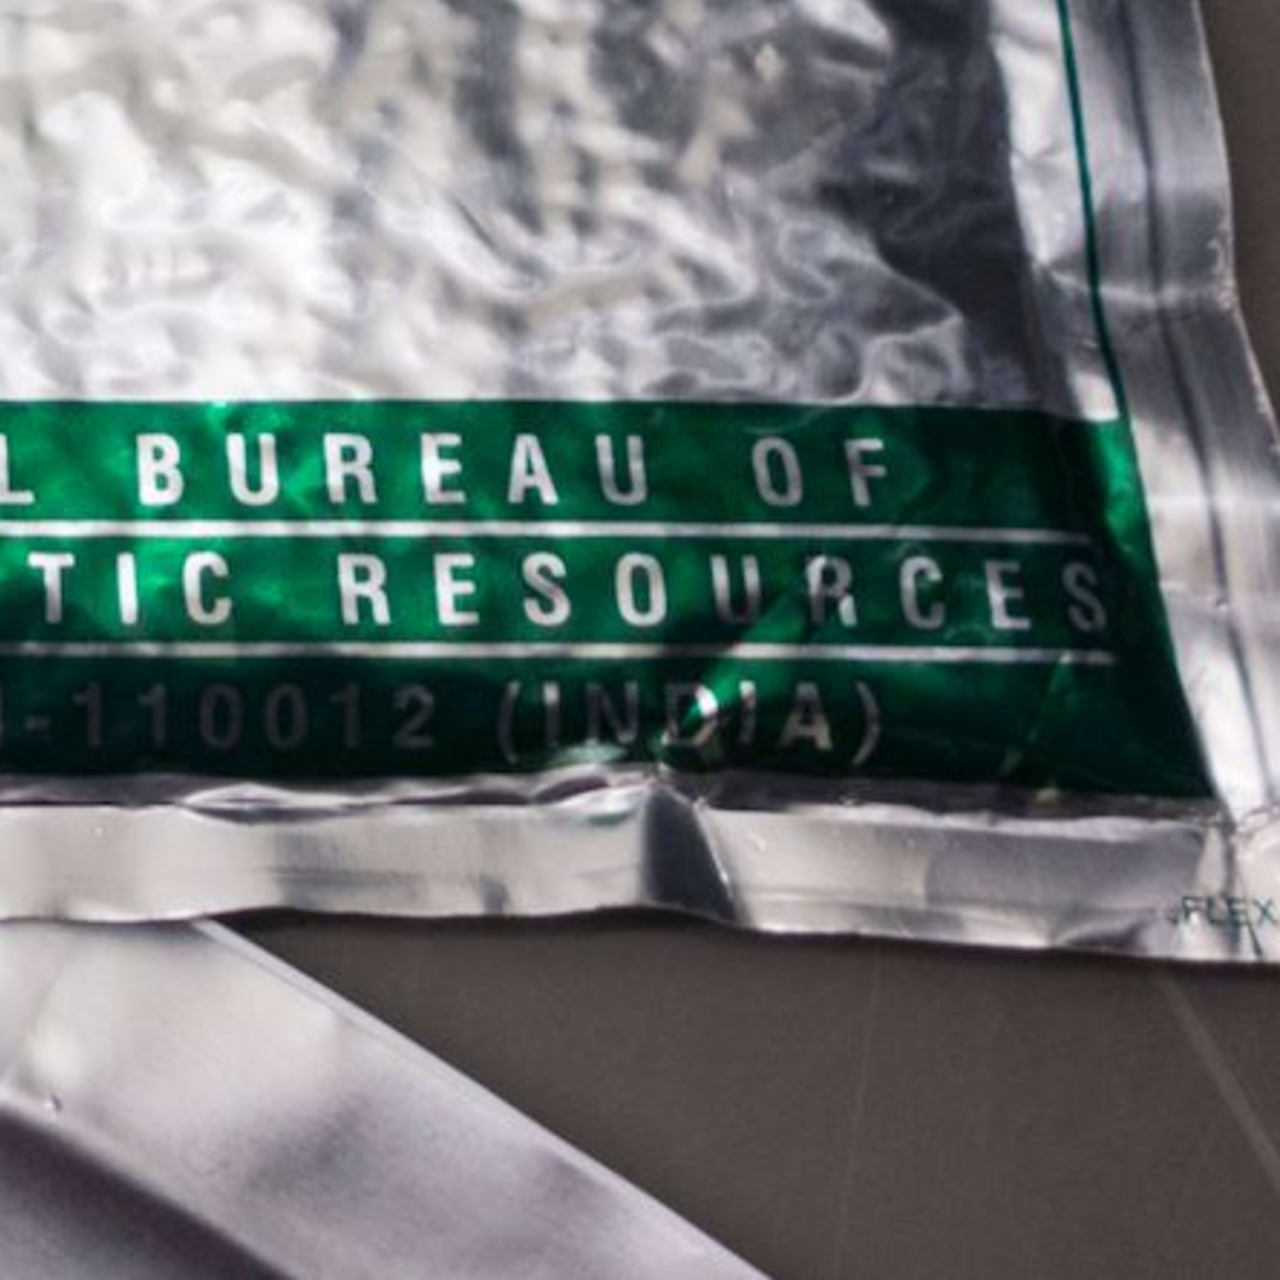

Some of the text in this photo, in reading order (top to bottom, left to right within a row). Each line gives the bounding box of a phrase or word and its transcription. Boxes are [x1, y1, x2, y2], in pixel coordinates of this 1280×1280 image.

[135, 431, 649, 508] BUREAU
[751, 435, 888, 507] OF
[338, 551, 1110, 633] RESOURCES
[496, 679, 883, 765] (INDIA)
